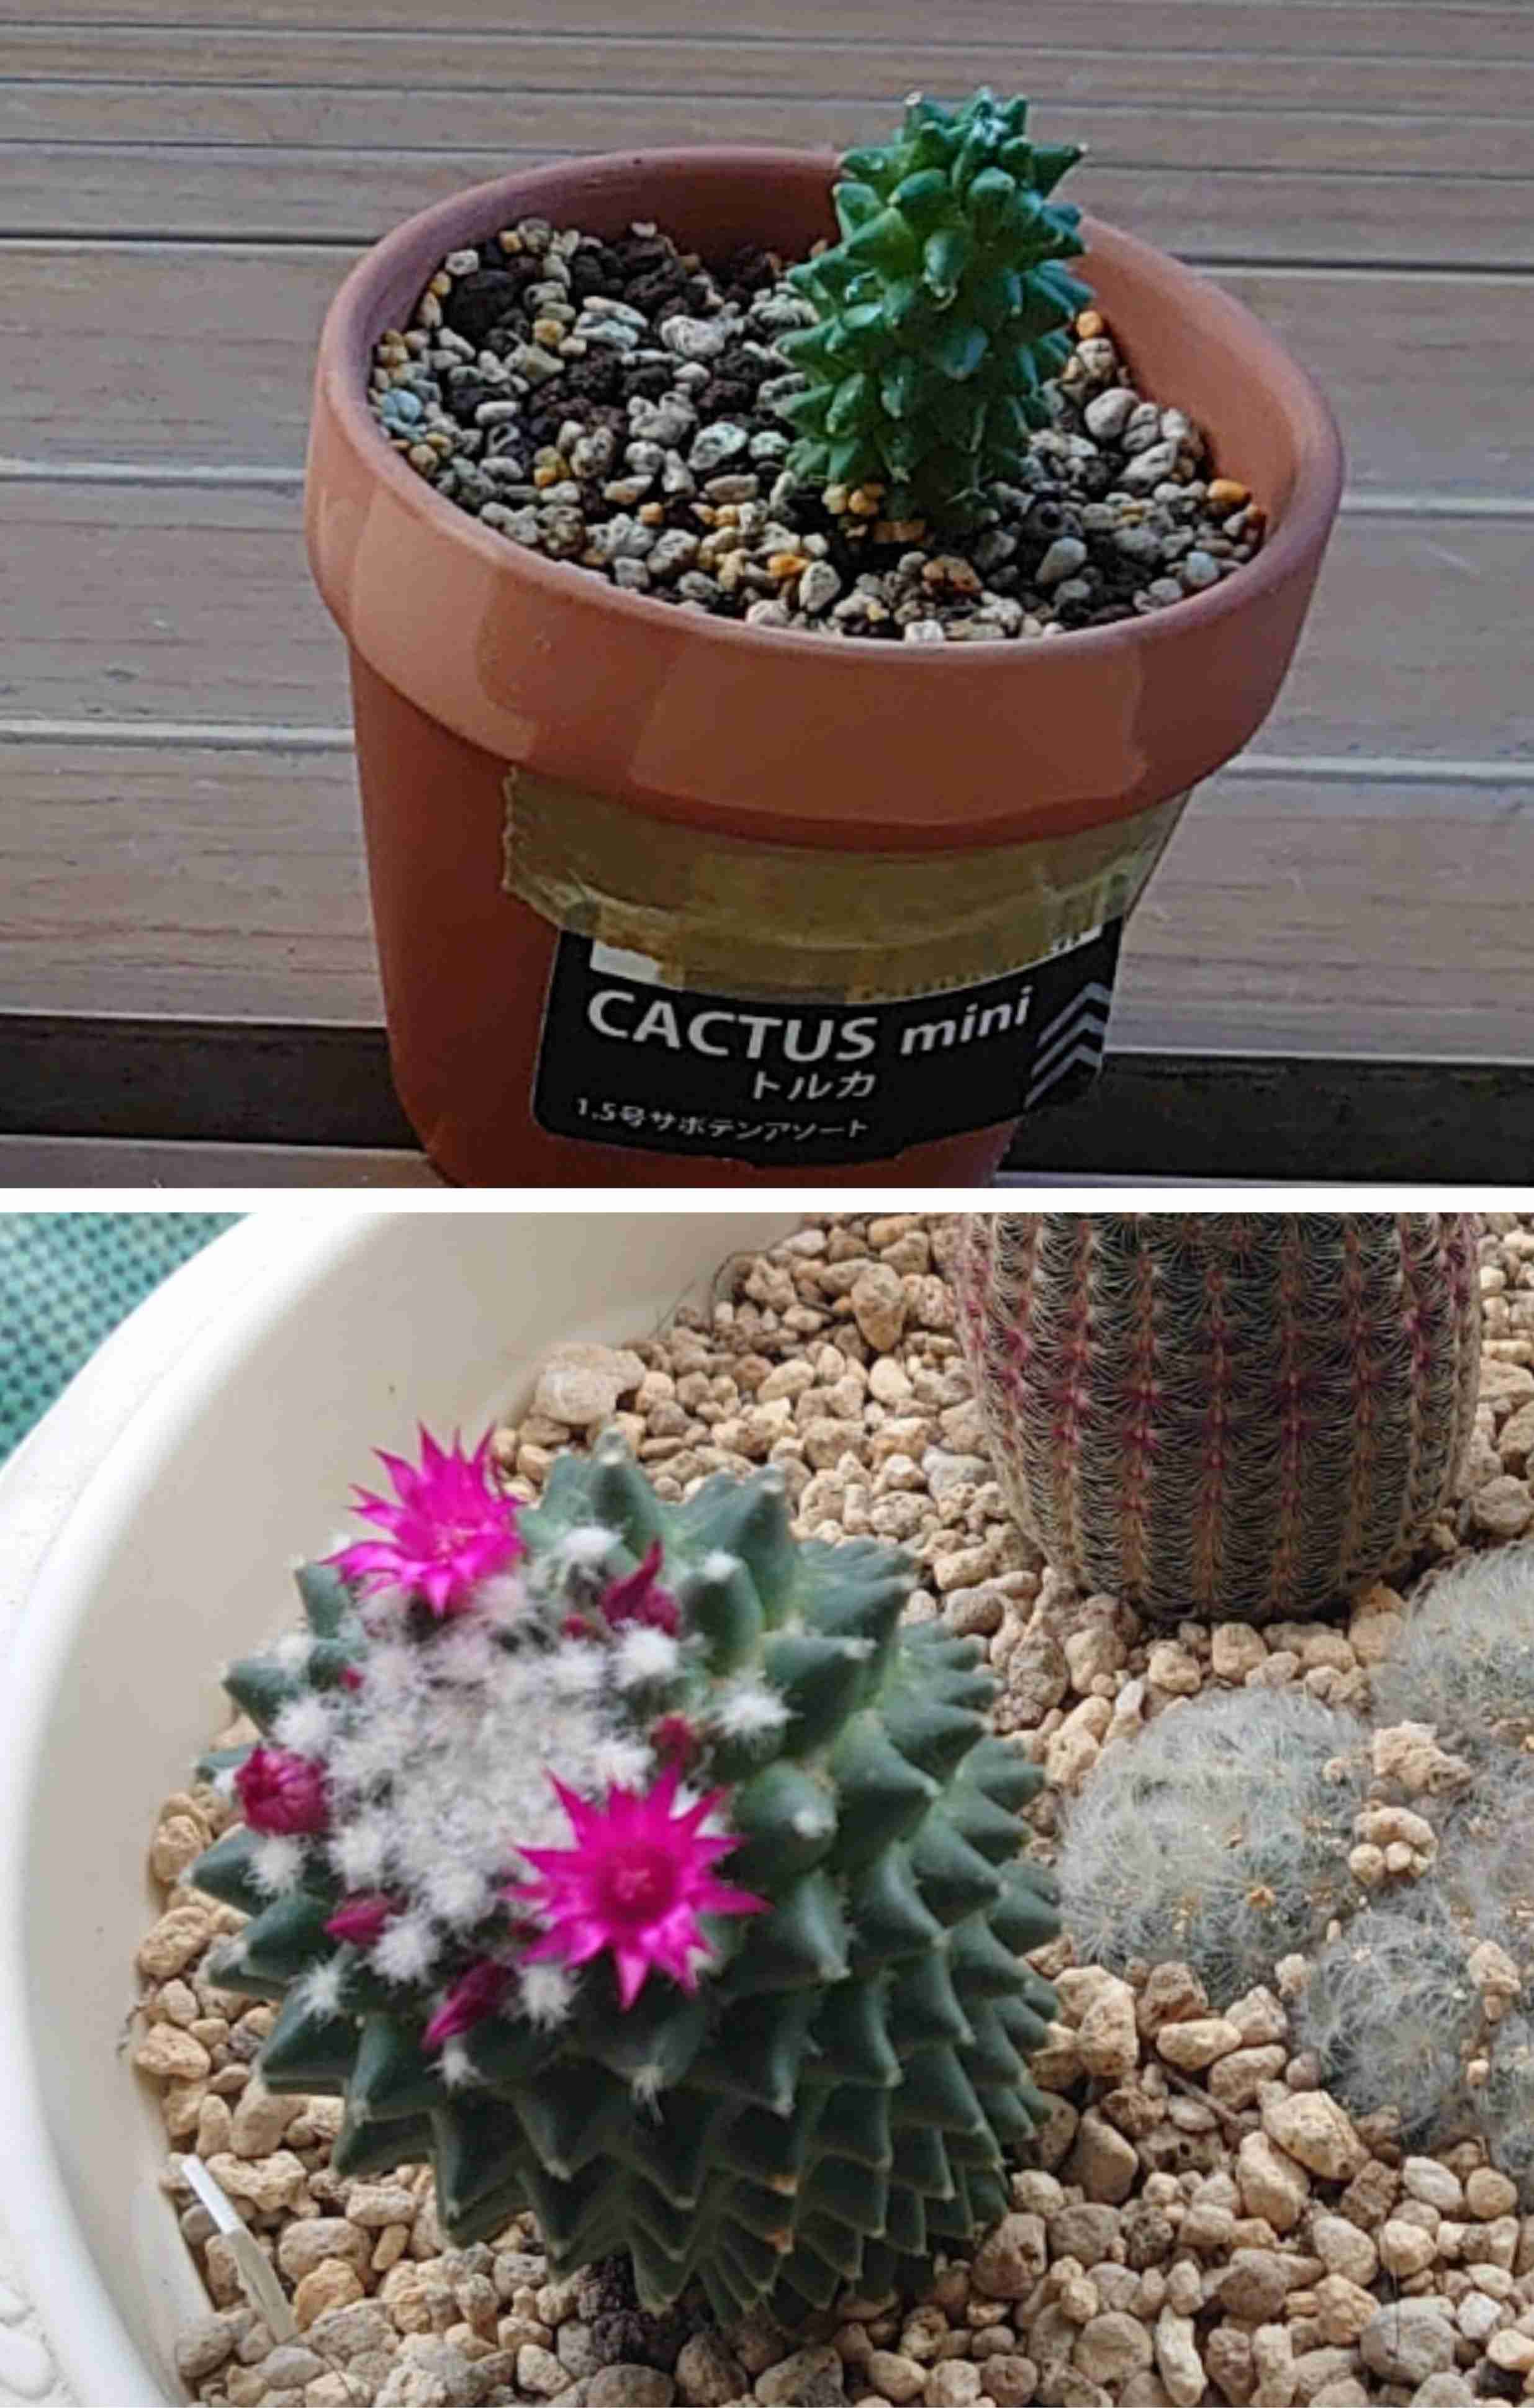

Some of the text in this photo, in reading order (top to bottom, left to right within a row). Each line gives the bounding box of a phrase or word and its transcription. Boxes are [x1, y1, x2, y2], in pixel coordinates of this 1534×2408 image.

[587, 986, 1032, 1062] CACTUS mini
[753, 1070, 876, 1100] トルカ
